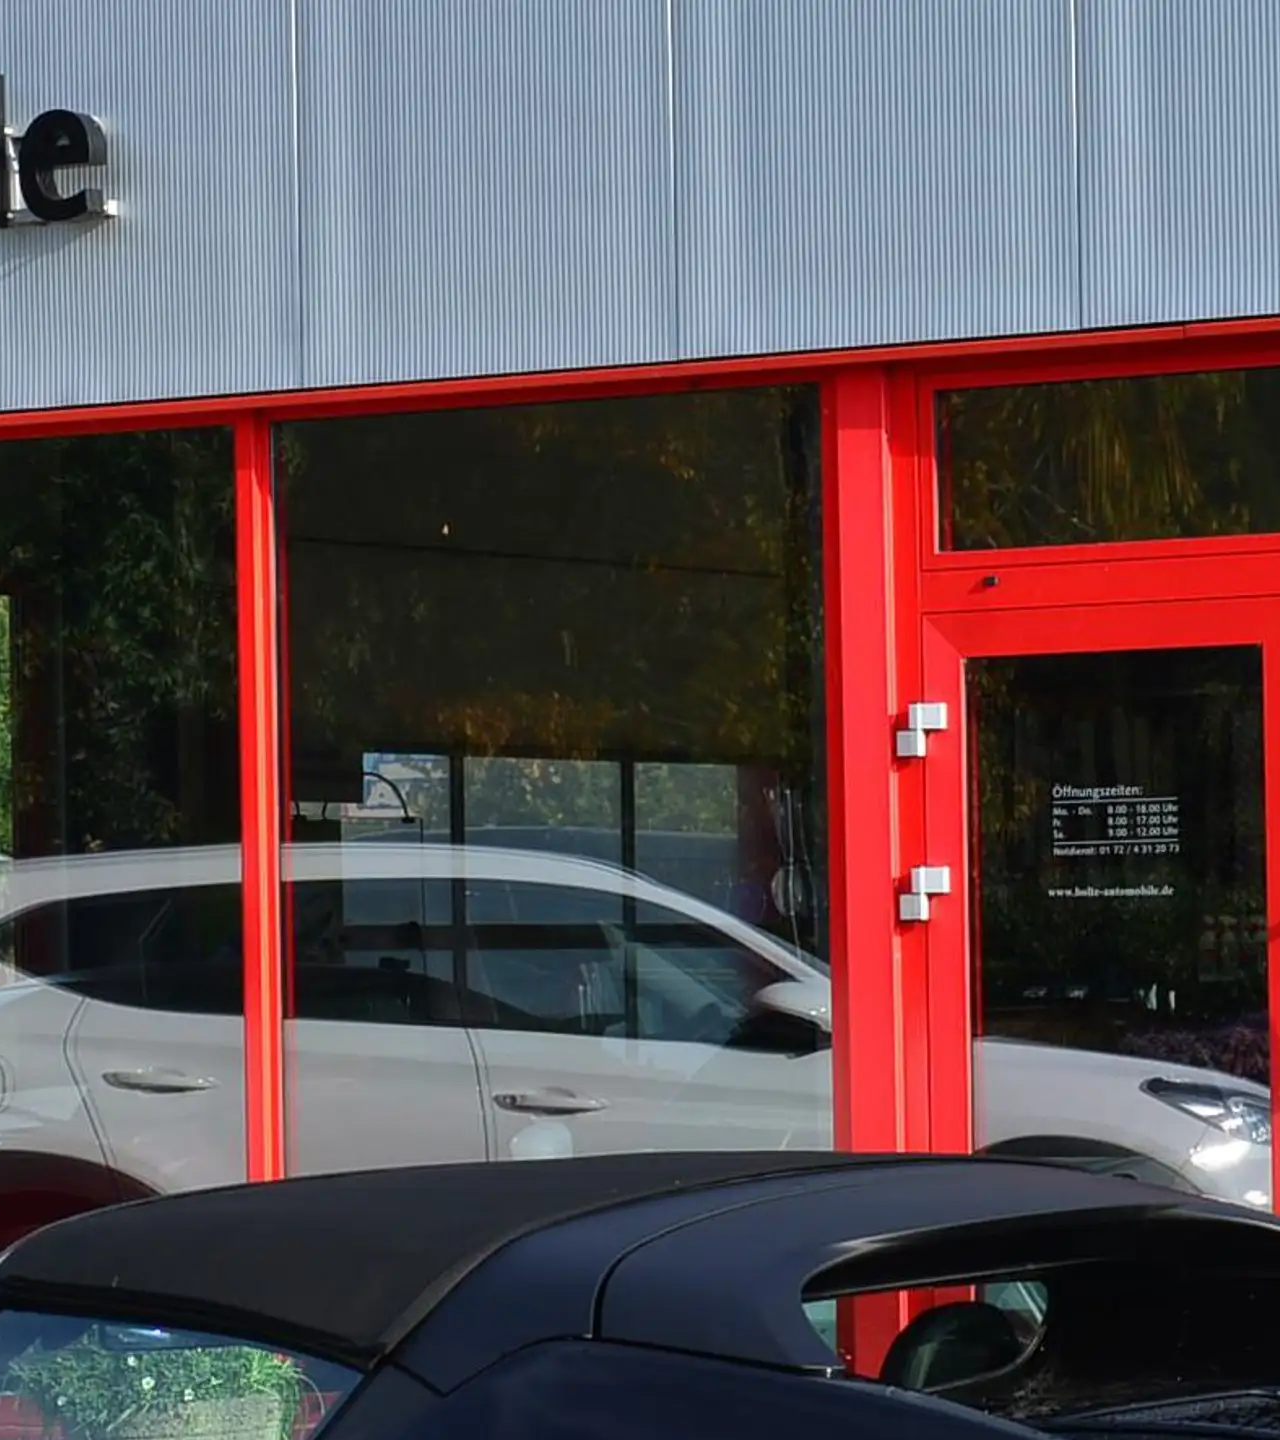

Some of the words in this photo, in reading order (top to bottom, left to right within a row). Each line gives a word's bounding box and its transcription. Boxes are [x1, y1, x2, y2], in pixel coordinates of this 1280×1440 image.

[1051, 783, 1144, 800] Öffnungszeiten:
[1162, 803, 1179, 813] Uhr
[1135, 815, 1161, 825] 17.00
[1162, 814, 1179, 824] Uhr
[1136, 826, 1161, 837] 12.00
[1163, 826, 1179, 836] Uhr
[1052, 846, 1098, 857] Notdienst:
[1099, 845, 1111, 855] 01
[1113, 845, 1125, 855] 72
[1154, 844, 1167, 854] 20
[1048, 884, 1174, 898] www.bolte-automobile.de
